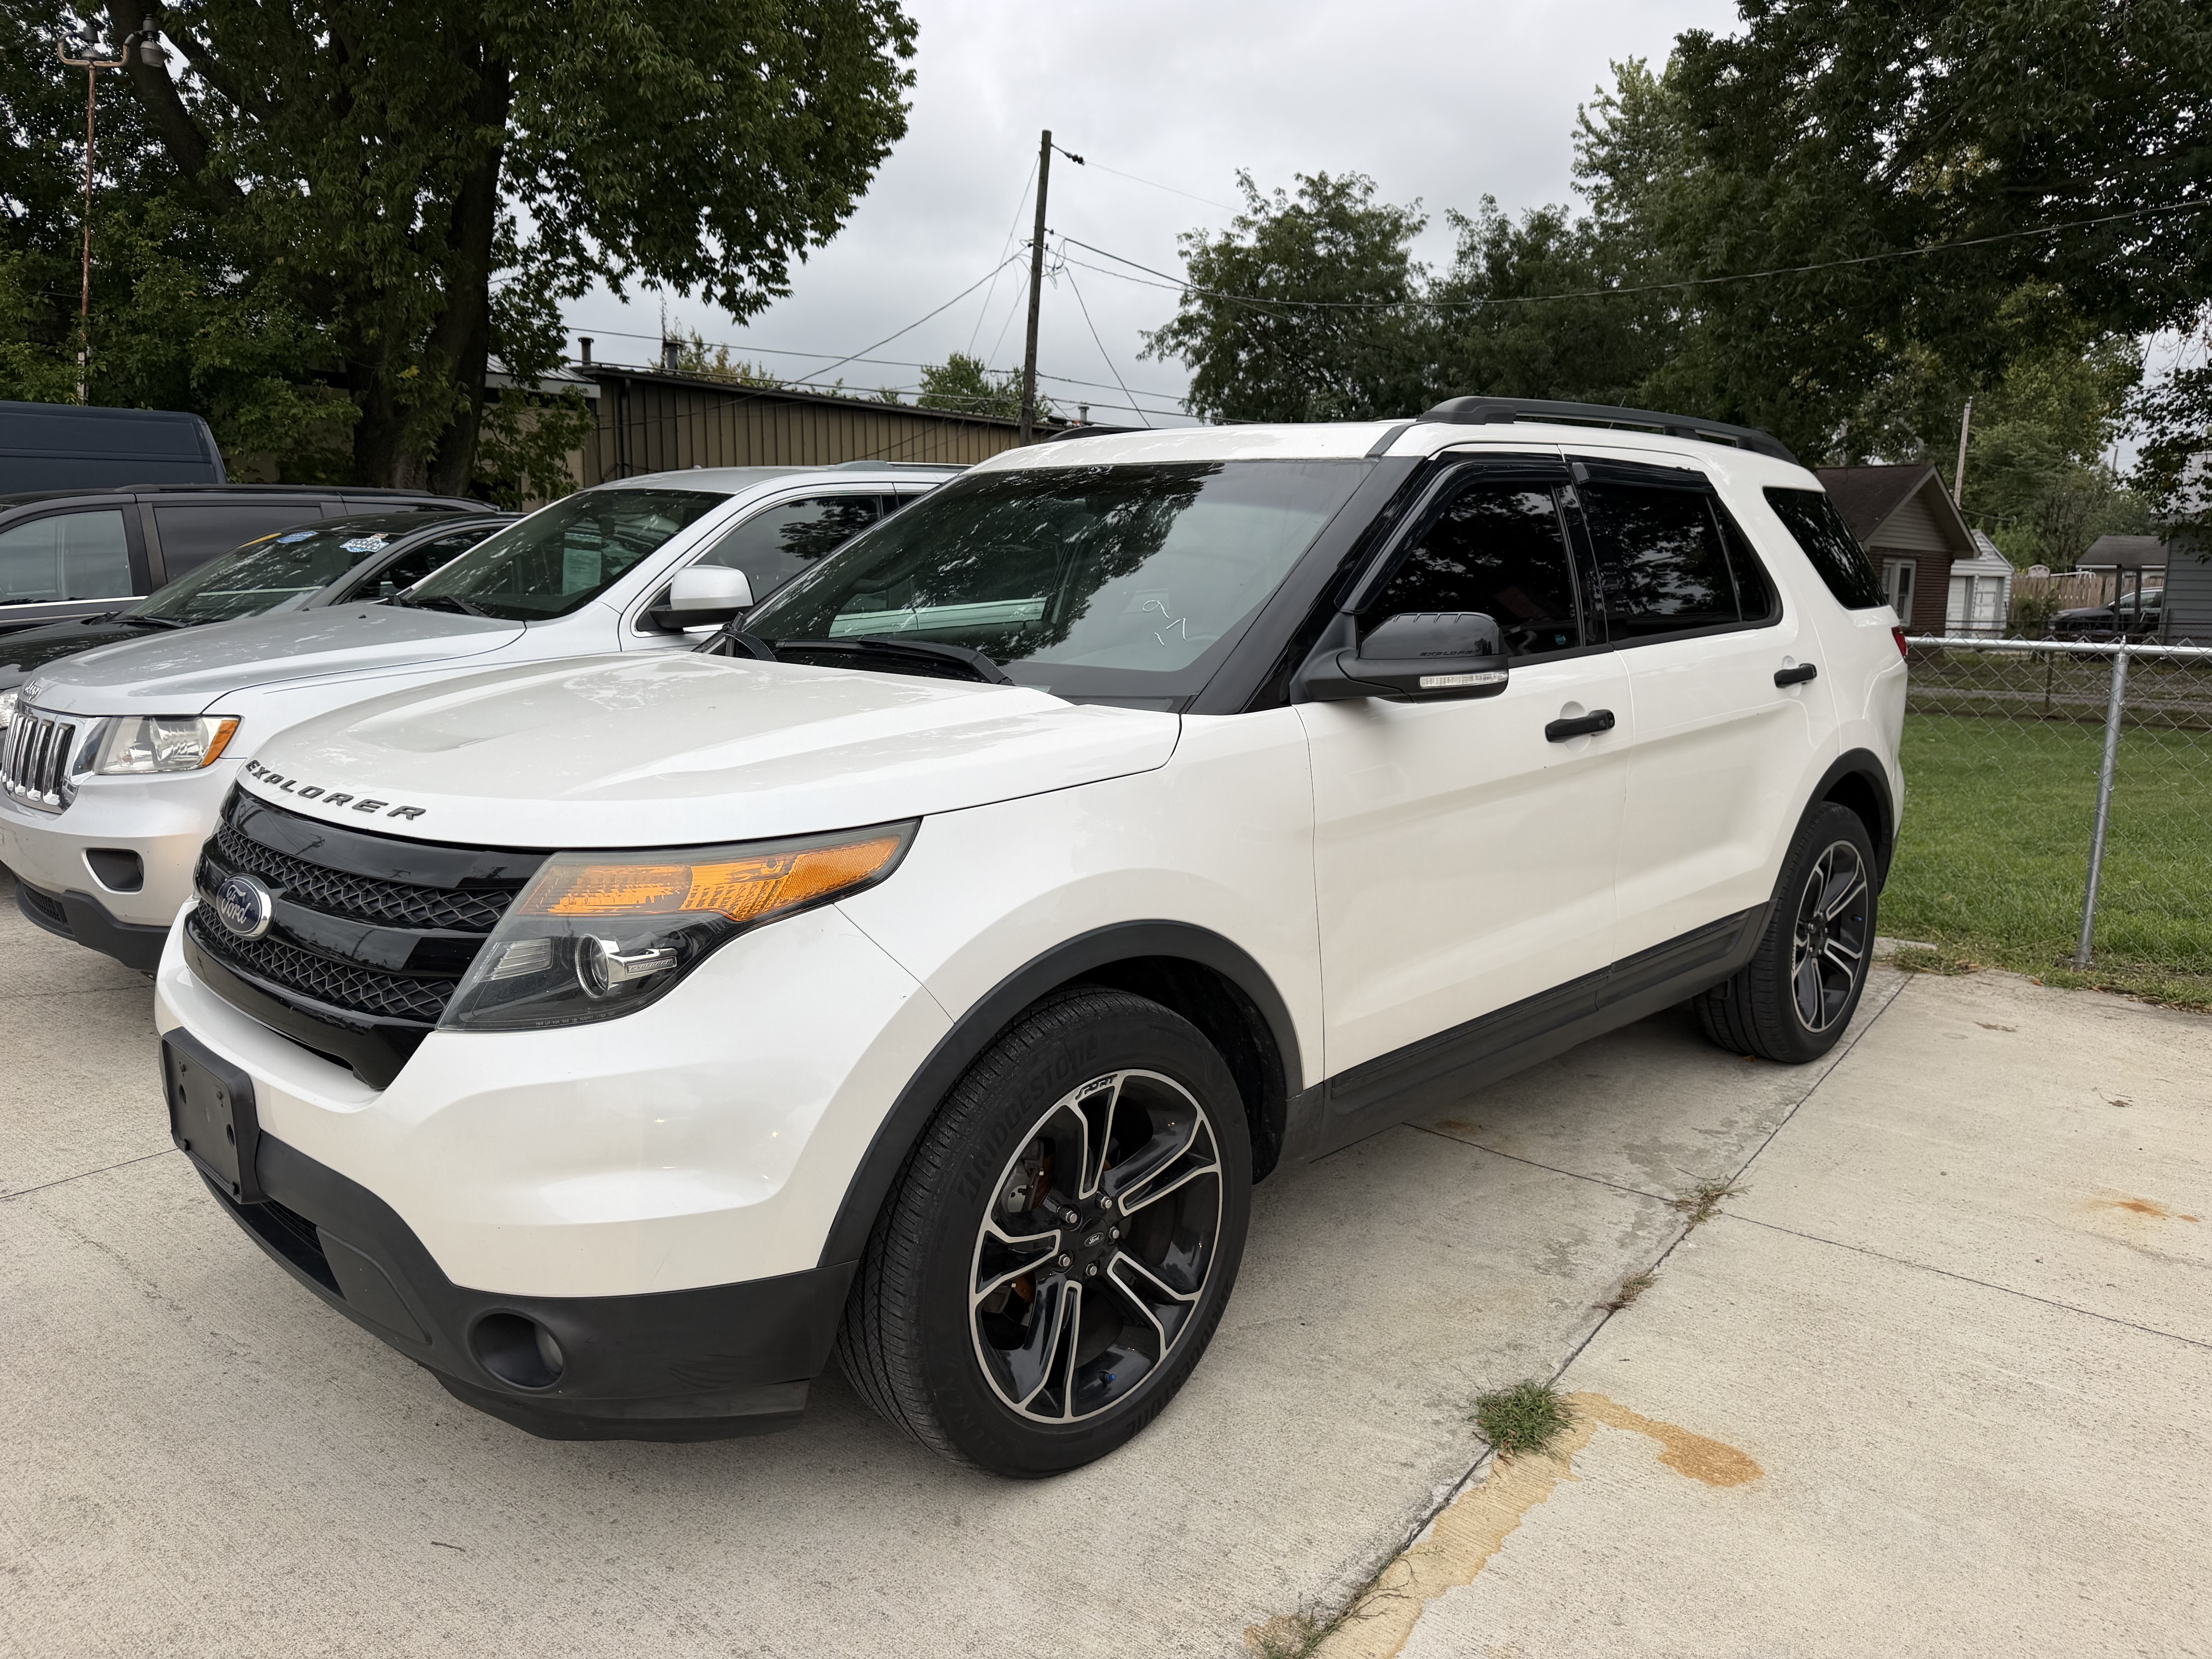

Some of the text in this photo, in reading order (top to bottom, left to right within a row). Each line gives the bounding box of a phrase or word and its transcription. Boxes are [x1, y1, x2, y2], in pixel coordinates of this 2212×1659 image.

[24, 679, 40, 701] Jeep
[245, 759, 426, 821] EXPLORER
[221, 884, 252, 925] Ford
[1075, 1073, 1118, 1100] SPORT
[957, 1034, 1099, 1206] BRIDGESTONE
[1089, 1235, 1100, 1245] Ford
